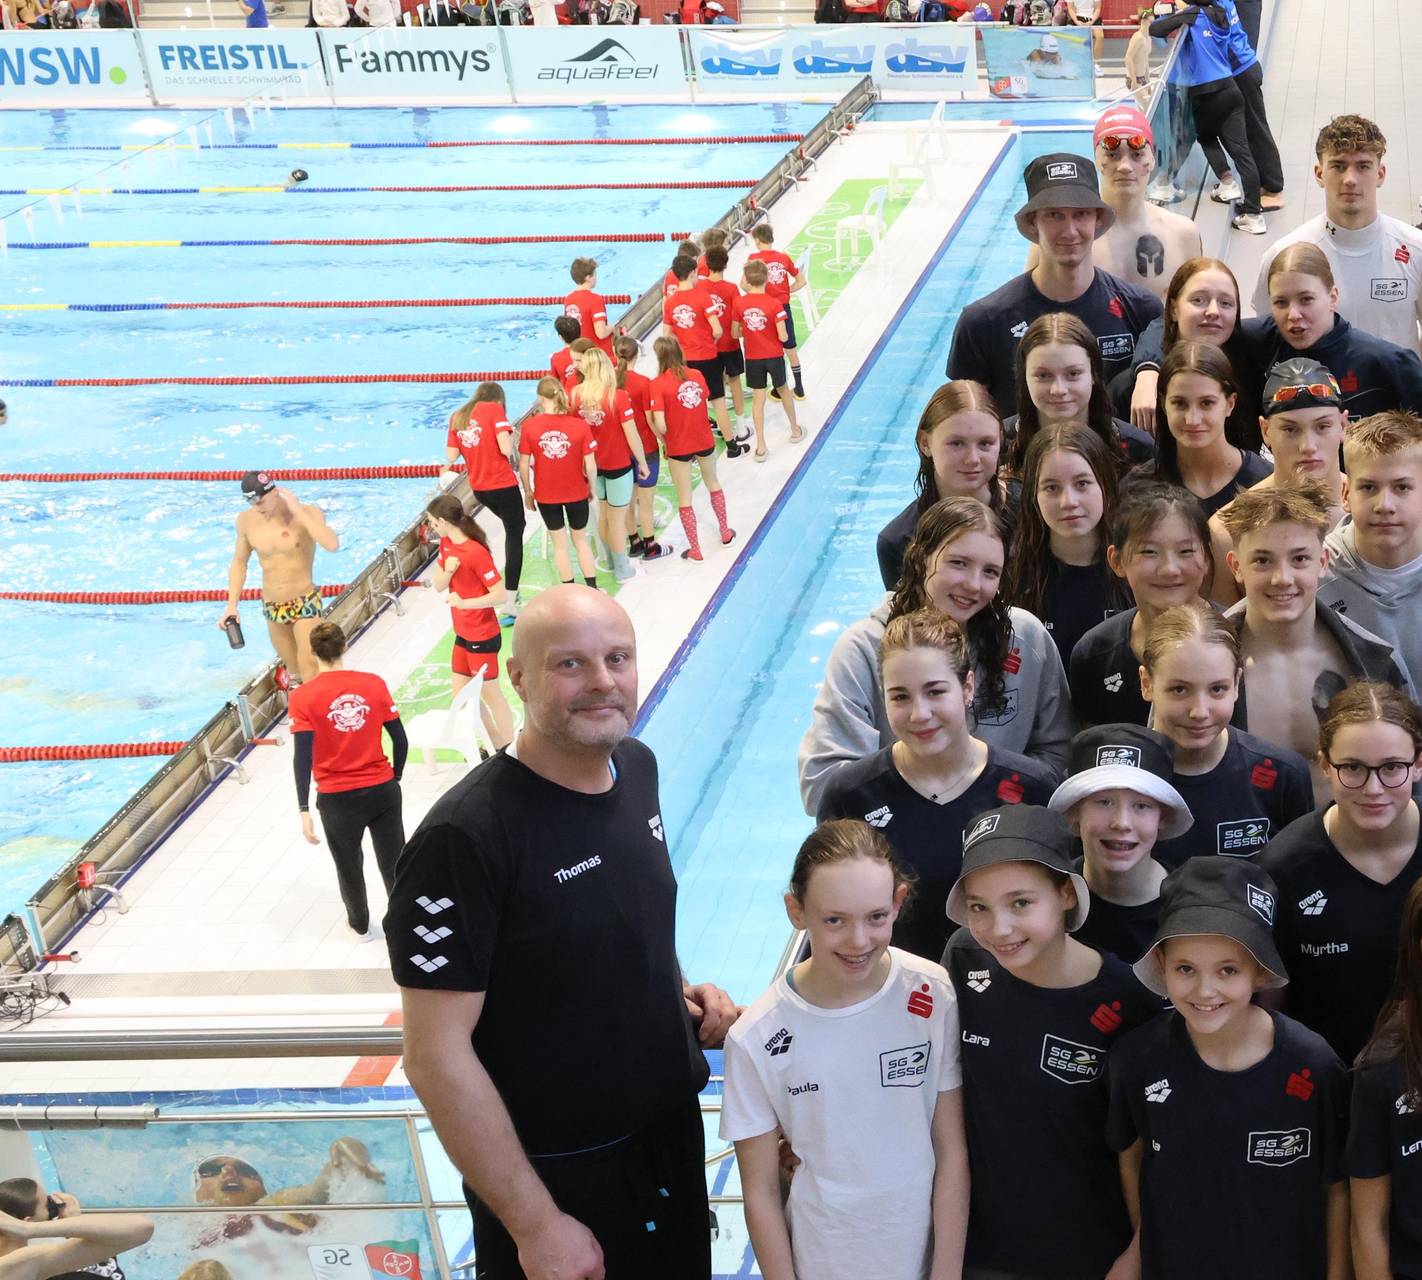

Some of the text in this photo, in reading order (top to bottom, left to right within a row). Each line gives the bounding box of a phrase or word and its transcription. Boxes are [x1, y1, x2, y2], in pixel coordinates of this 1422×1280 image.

[537, 64, 659, 84] aquafeel
[1102, 341, 1115, 349] SG
[1102, 347, 1131, 356] ESSEN
[1100, 758, 1136, 766] ESSEN
[865, 805, 890, 821] arena
[1224, 829, 1244, 839] SG
[1223, 836, 1266, 849] ESSEN
[553, 854, 602, 884] Thomas
[1299, 889, 1324, 909] arena
[1301, 941, 1349, 957] Myrtha
[968, 969, 990, 980] arena
[764, 1028, 788, 1052] arena
[962, 1030, 991, 1047] Lara
[1049, 1046, 1071, 1060] SG
[888, 1057, 908, 1069] SG
[1047, 1057, 1098, 1076] ESSEN
[887, 1065, 925, 1080] ESSE
[787, 1081, 819, 1096] aula
[1145, 1079, 1169, 1096] arena
[1254, 1145, 1303, 1158] ESSEN
[1256, 1139, 1277, 1149] SG
